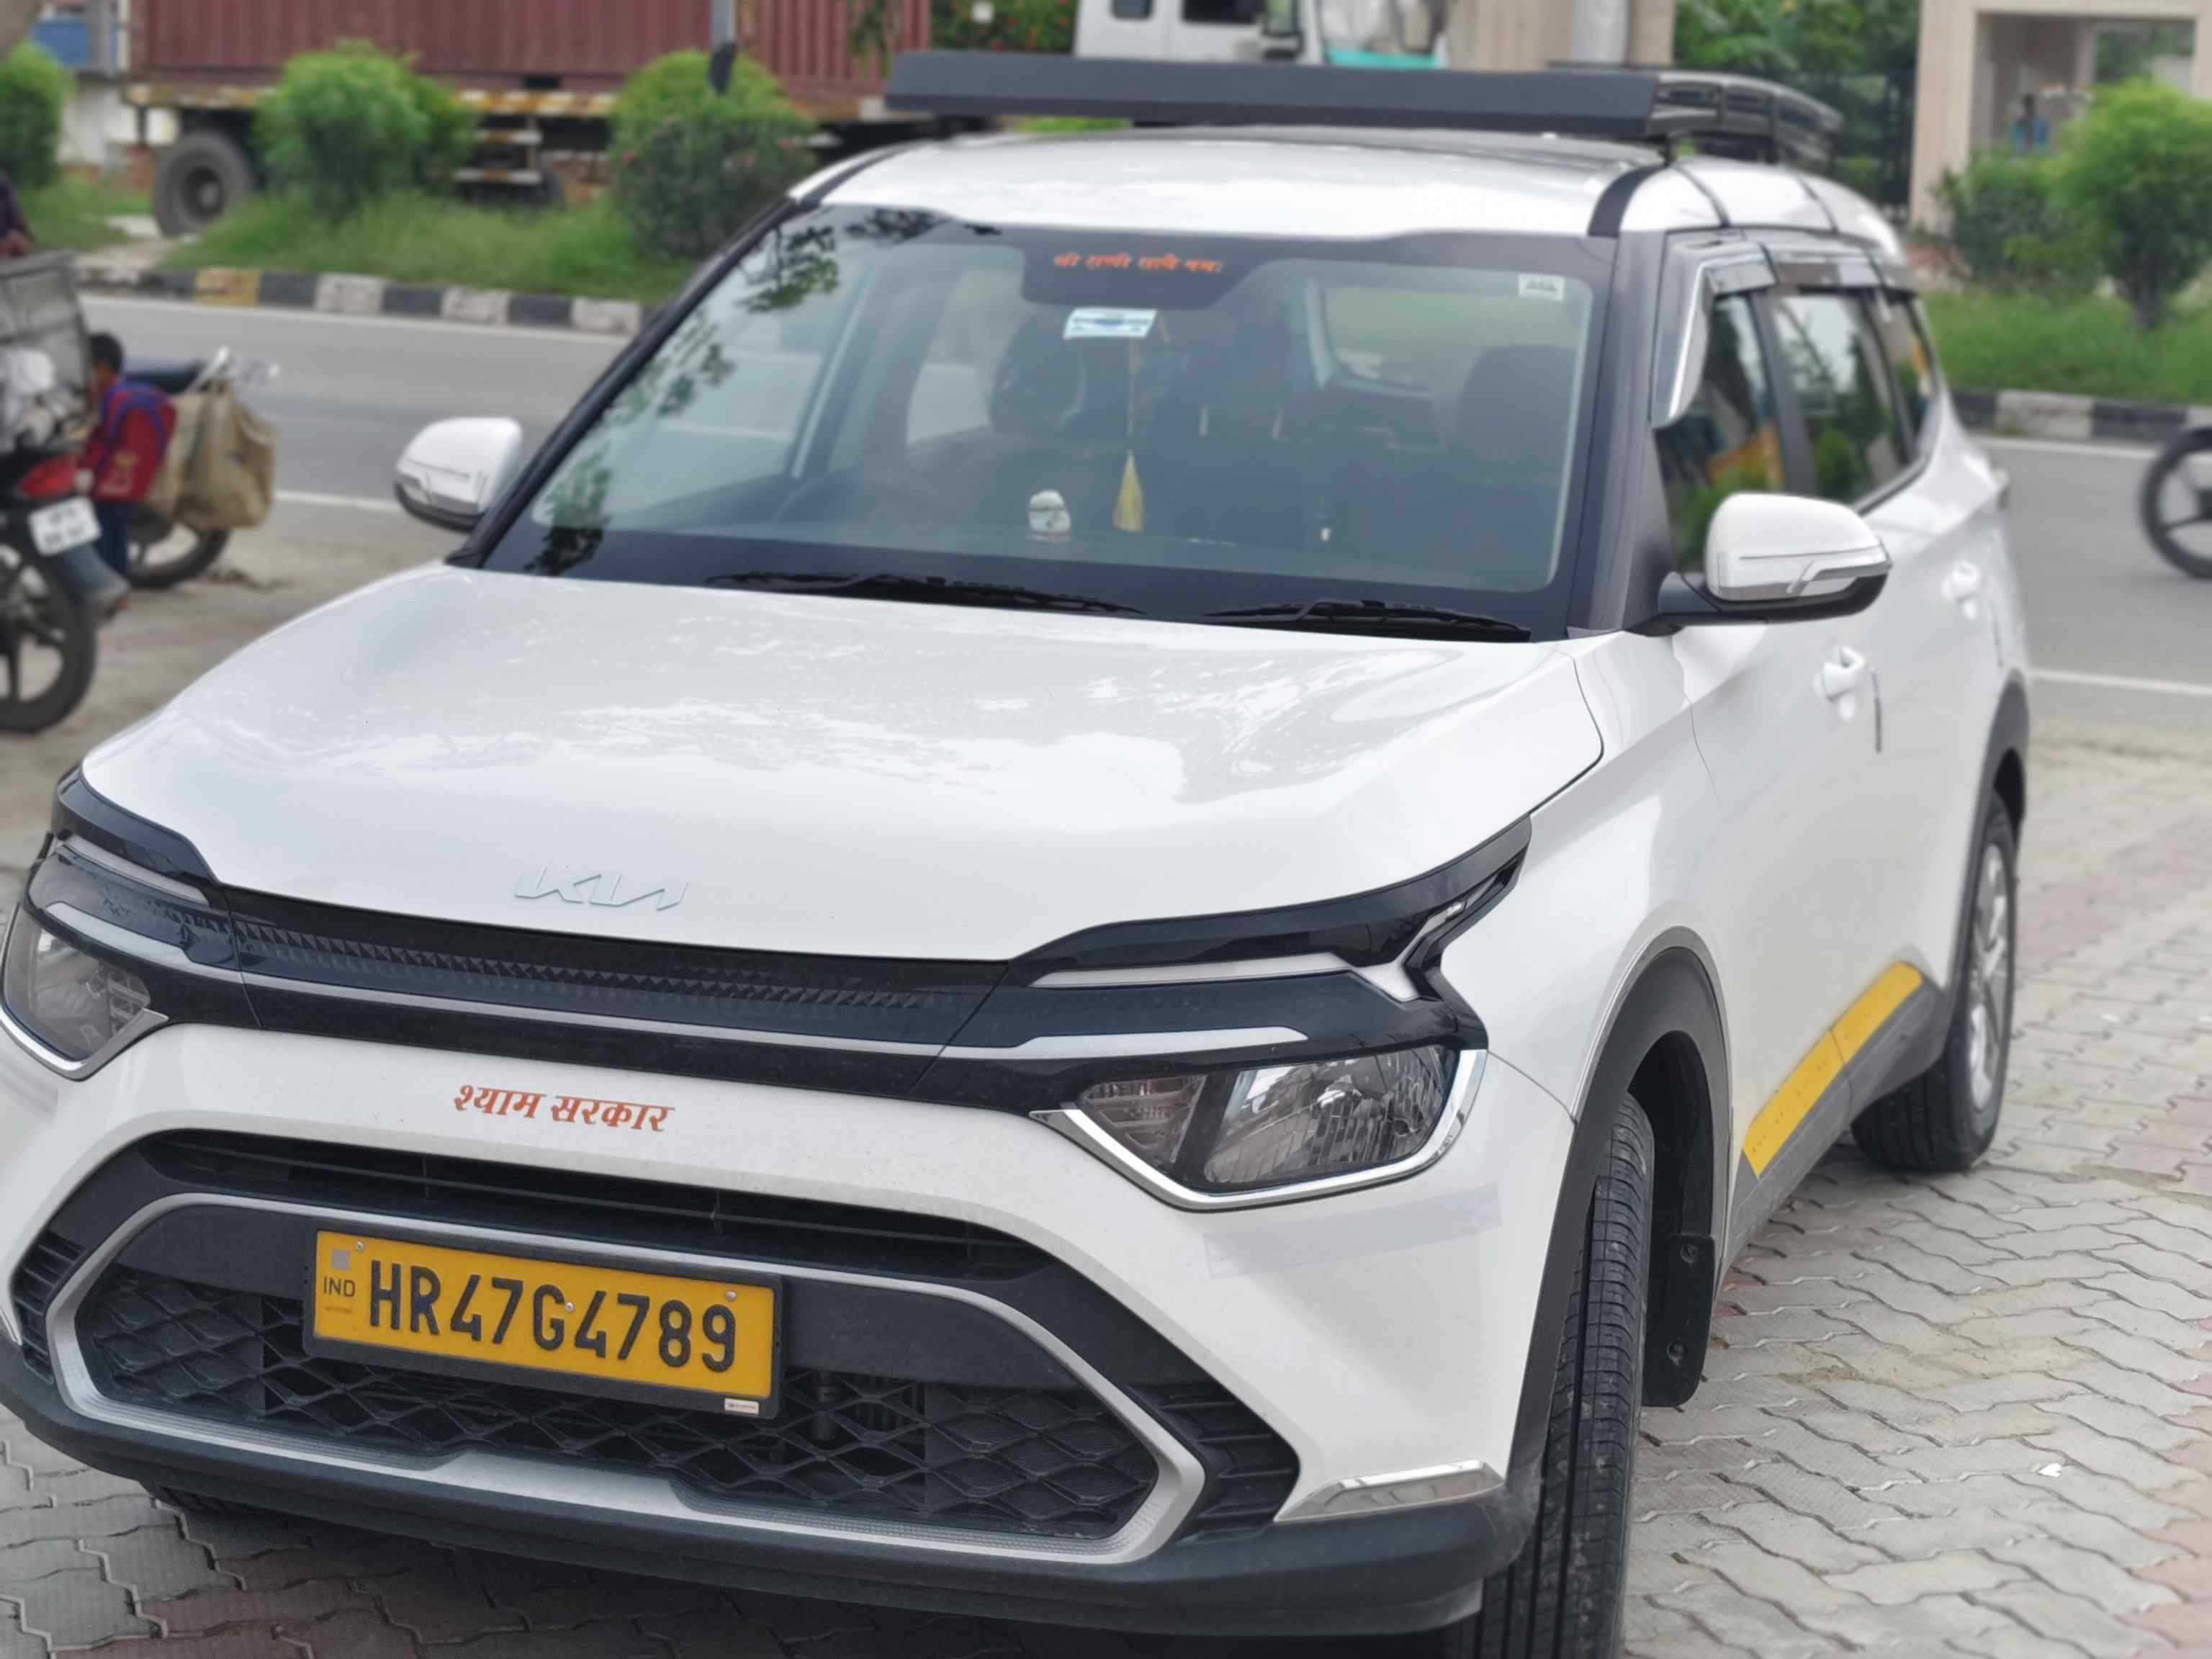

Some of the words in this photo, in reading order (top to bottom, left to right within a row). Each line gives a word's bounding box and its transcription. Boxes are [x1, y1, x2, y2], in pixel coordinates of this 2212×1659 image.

[513, 868, 689, 912] KIA
[454, 1084, 547, 1118] श्याम
[551, 1095, 675, 1132] सरकार
[323, 1276, 356, 1298] IND
[369, 1259, 737, 1373] HR47G4789
